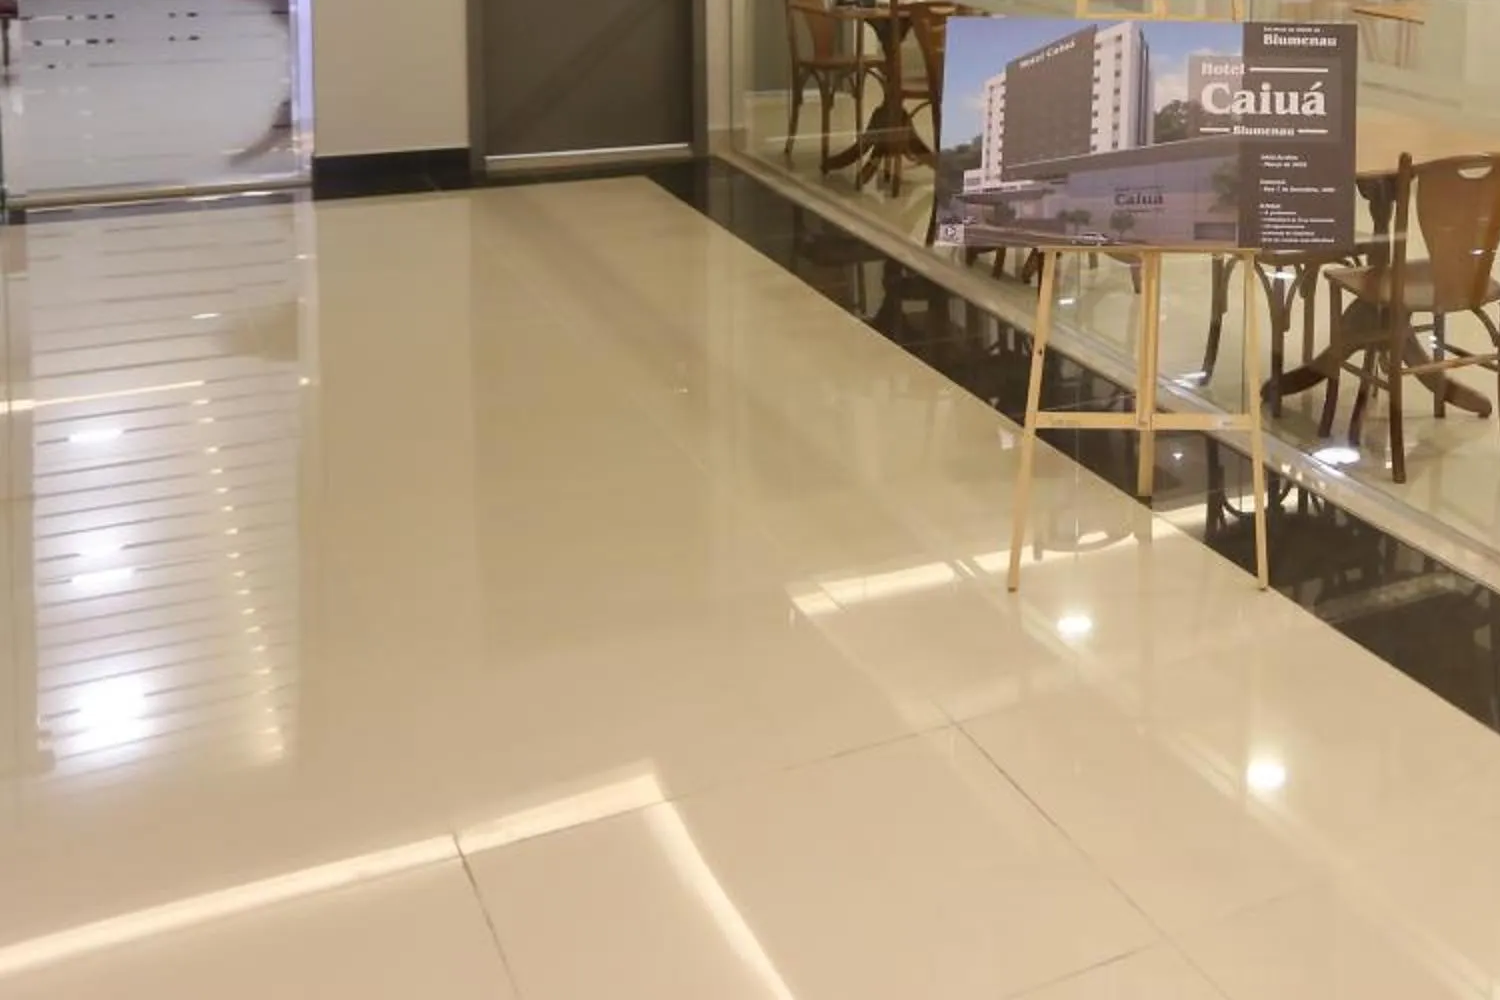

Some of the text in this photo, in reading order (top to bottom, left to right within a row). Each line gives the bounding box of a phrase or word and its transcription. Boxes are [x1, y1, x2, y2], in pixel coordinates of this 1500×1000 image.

[1263, 33, 1338, 47] Blumenau
[1201, 62, 1246, 76] Hotel
[1201, 81, 1328, 116] Caiuá
[1232, 124, 1296, 136] Blumenau
